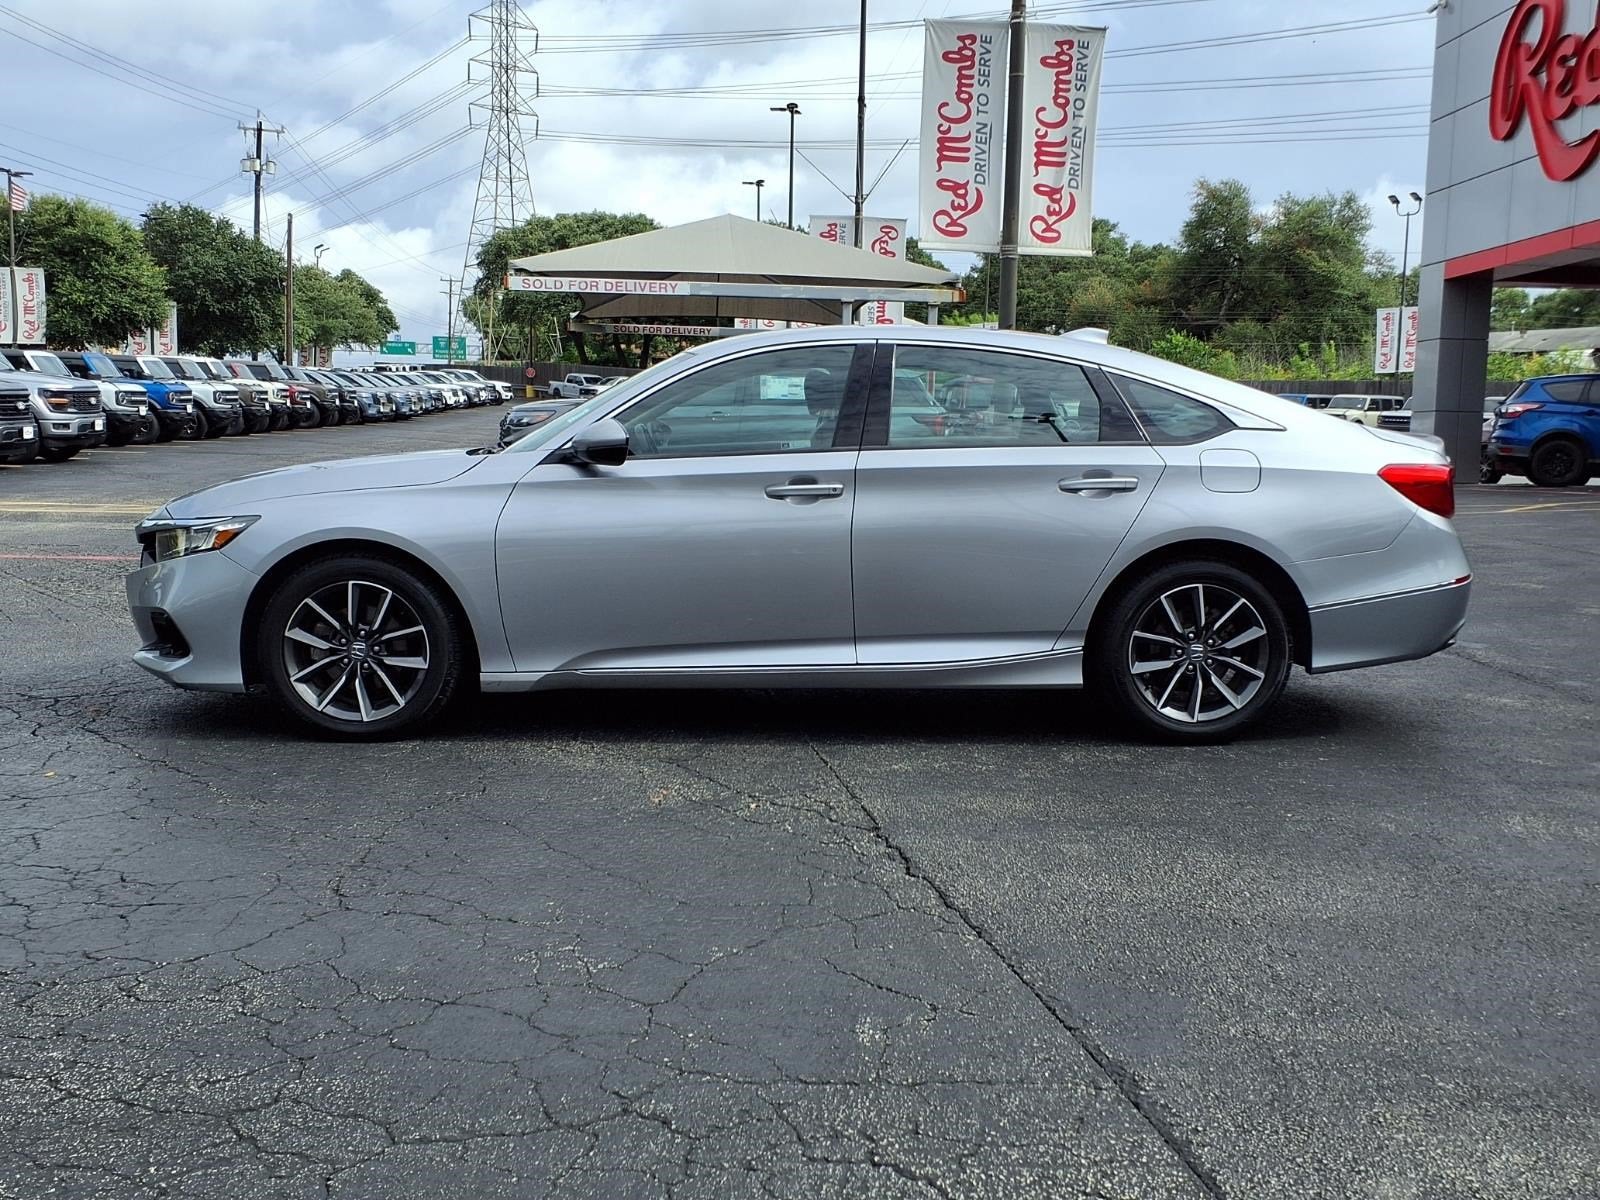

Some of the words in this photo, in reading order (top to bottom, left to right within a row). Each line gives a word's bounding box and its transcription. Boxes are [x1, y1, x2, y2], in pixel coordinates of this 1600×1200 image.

[978, 34, 993, 88] SERVE
[1074, 40, 1090, 92] SERVE
[935, 33, 978, 173] McCombs
[976, 93, 990, 117] TO
[1032, 38, 1075, 177] McCombs
[1072, 98, 1086, 120] TO
[974, 122, 989, 186] DRIVEN
[1068, 126, 1083, 190] DRIVEN
[932, 178, 984, 238] Red
[1029, 183, 1076, 244] Red
[871, 224, 899, 258] Red
[22, 272, 35, 318] McCombs
[521, 278, 564, 290] SOLD
[568, 279, 600, 291] FOR
[604, 280, 679, 294] DELIVERY
[22, 319, 40, 340] Red
[613, 325, 640, 333] SOLD
[664, 326, 712, 335] DELIVERY
